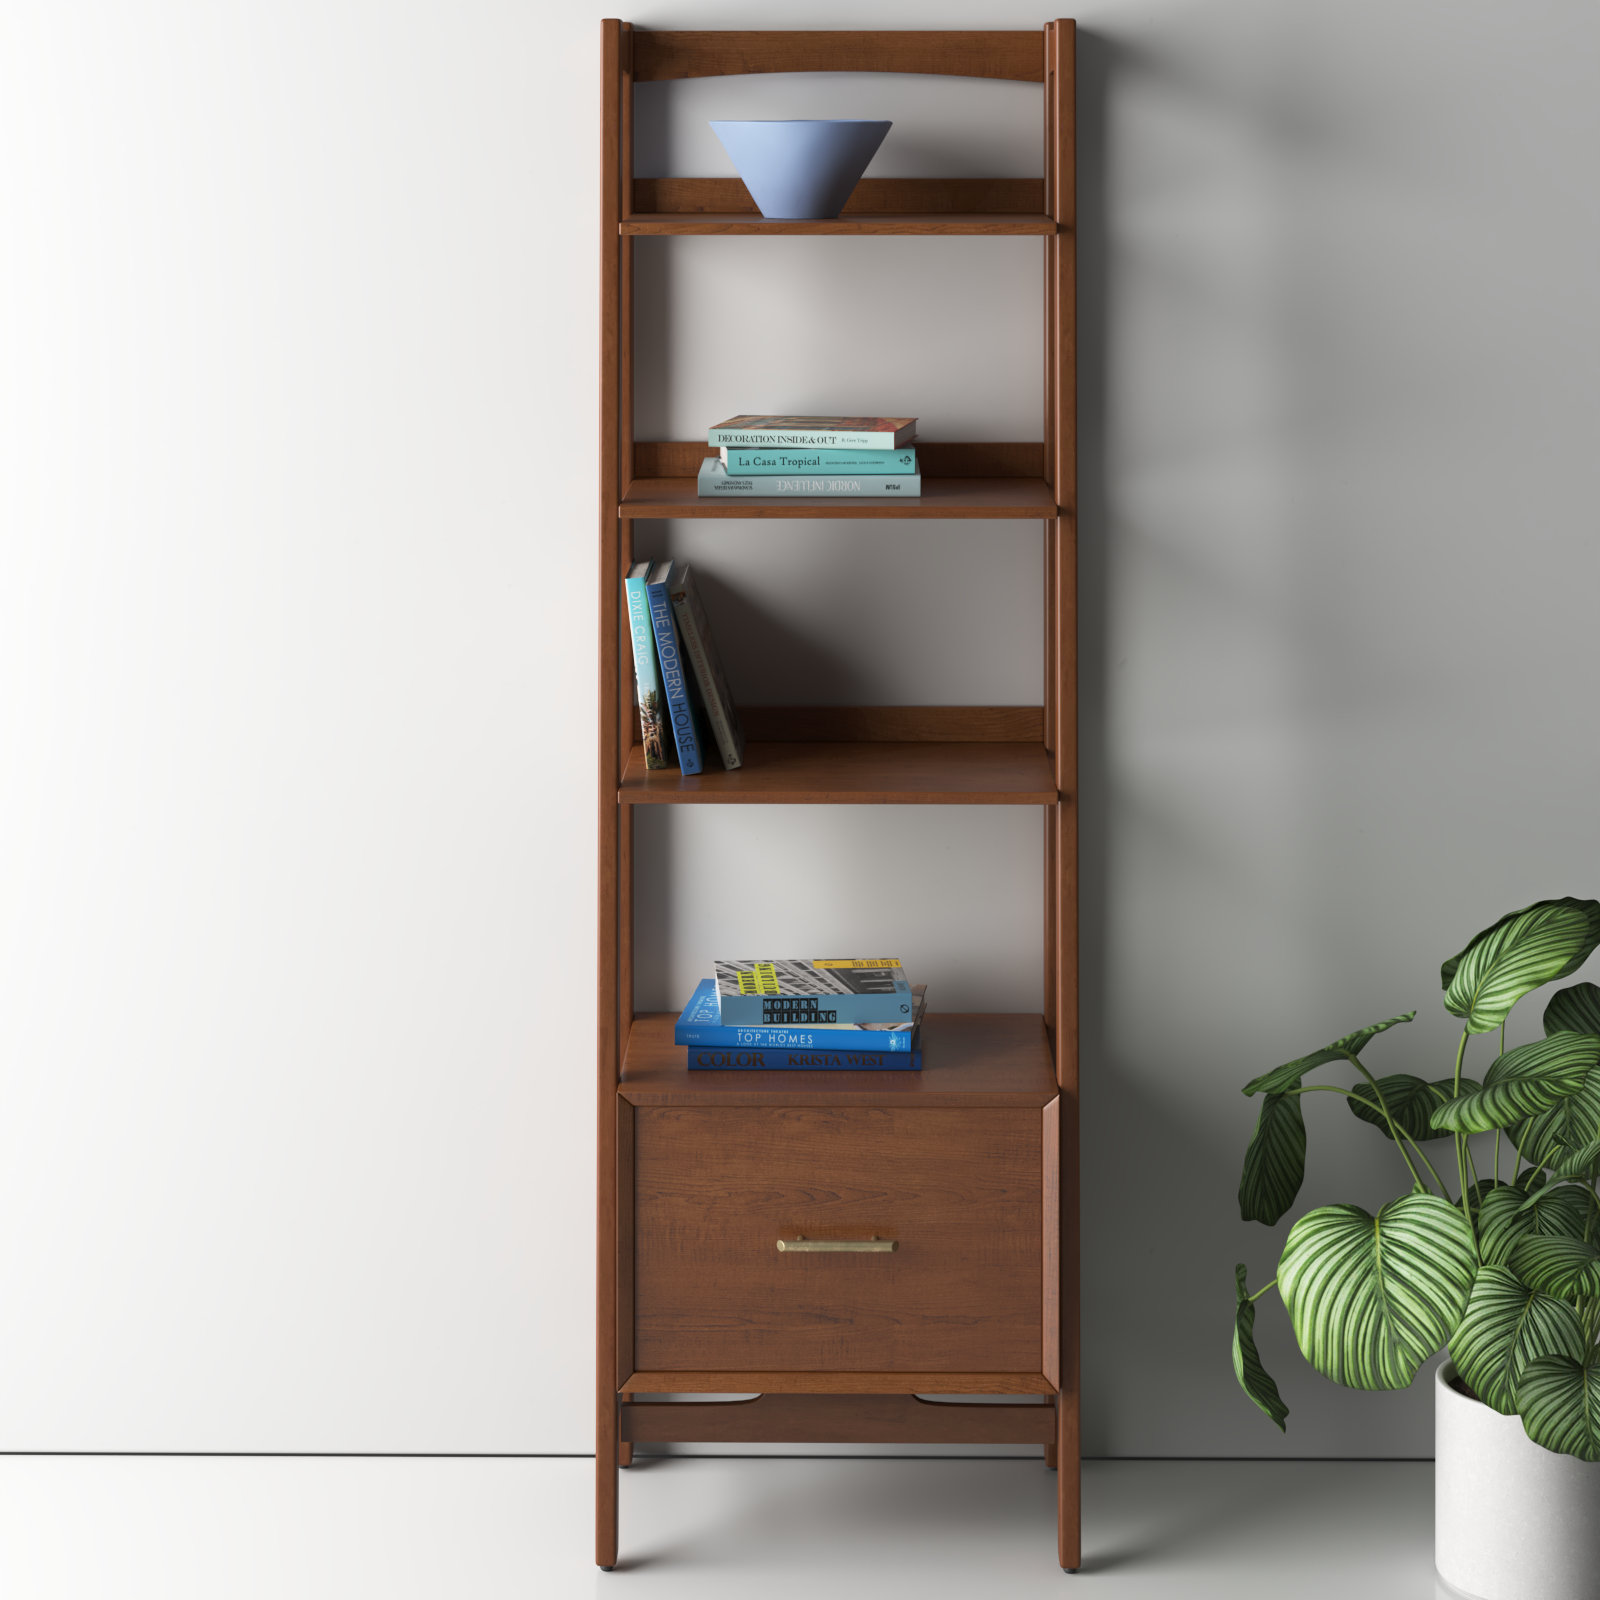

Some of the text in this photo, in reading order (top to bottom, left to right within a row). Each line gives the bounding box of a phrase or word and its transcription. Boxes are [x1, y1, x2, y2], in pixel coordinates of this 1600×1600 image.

[718, 434, 776, 443] DECORATION
[738, 455, 820, 469] La Casa Tropical
[777, 480, 861, 491] NORDIC INFLUENCE
[653, 601, 670, 628] THE
[630, 591, 649, 665] DIXIE CRAIG
[658, 632, 685, 699] MODERN
[672, 702, 695, 752] HOUSE
[763, 999, 818, 1010] MODERN
[763, 1011, 837, 1023] BUILDING
[737, 1033, 813, 1044] TOP HOMES
[697, 1052, 887, 1067] COLOR KRISTA WEST
